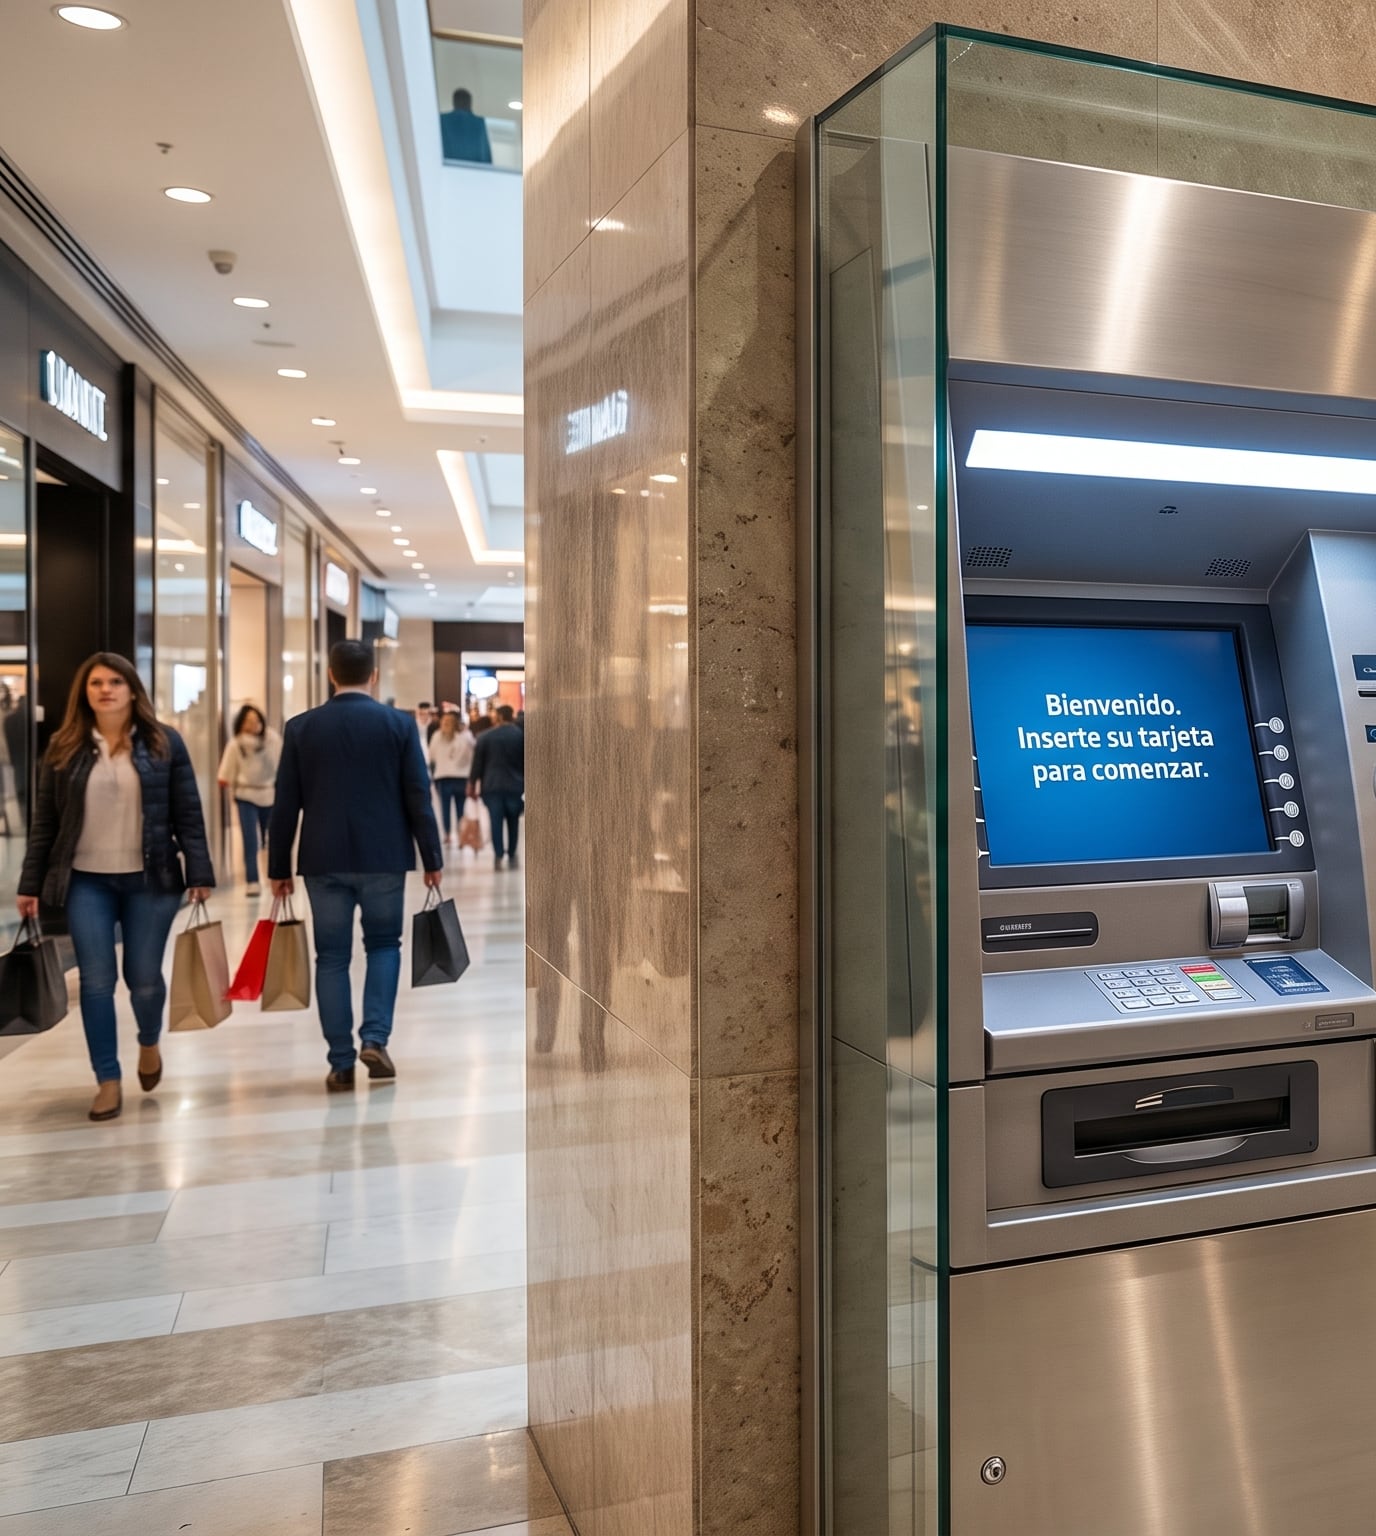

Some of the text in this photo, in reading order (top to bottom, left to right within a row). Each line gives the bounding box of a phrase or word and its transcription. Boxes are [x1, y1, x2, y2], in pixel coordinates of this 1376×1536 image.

[1045, 693, 1182, 716] Bienvenido.
[1017, 725, 1214, 753] Inserte su tarjeta
[1032, 761, 1209, 789] para comenzar.
